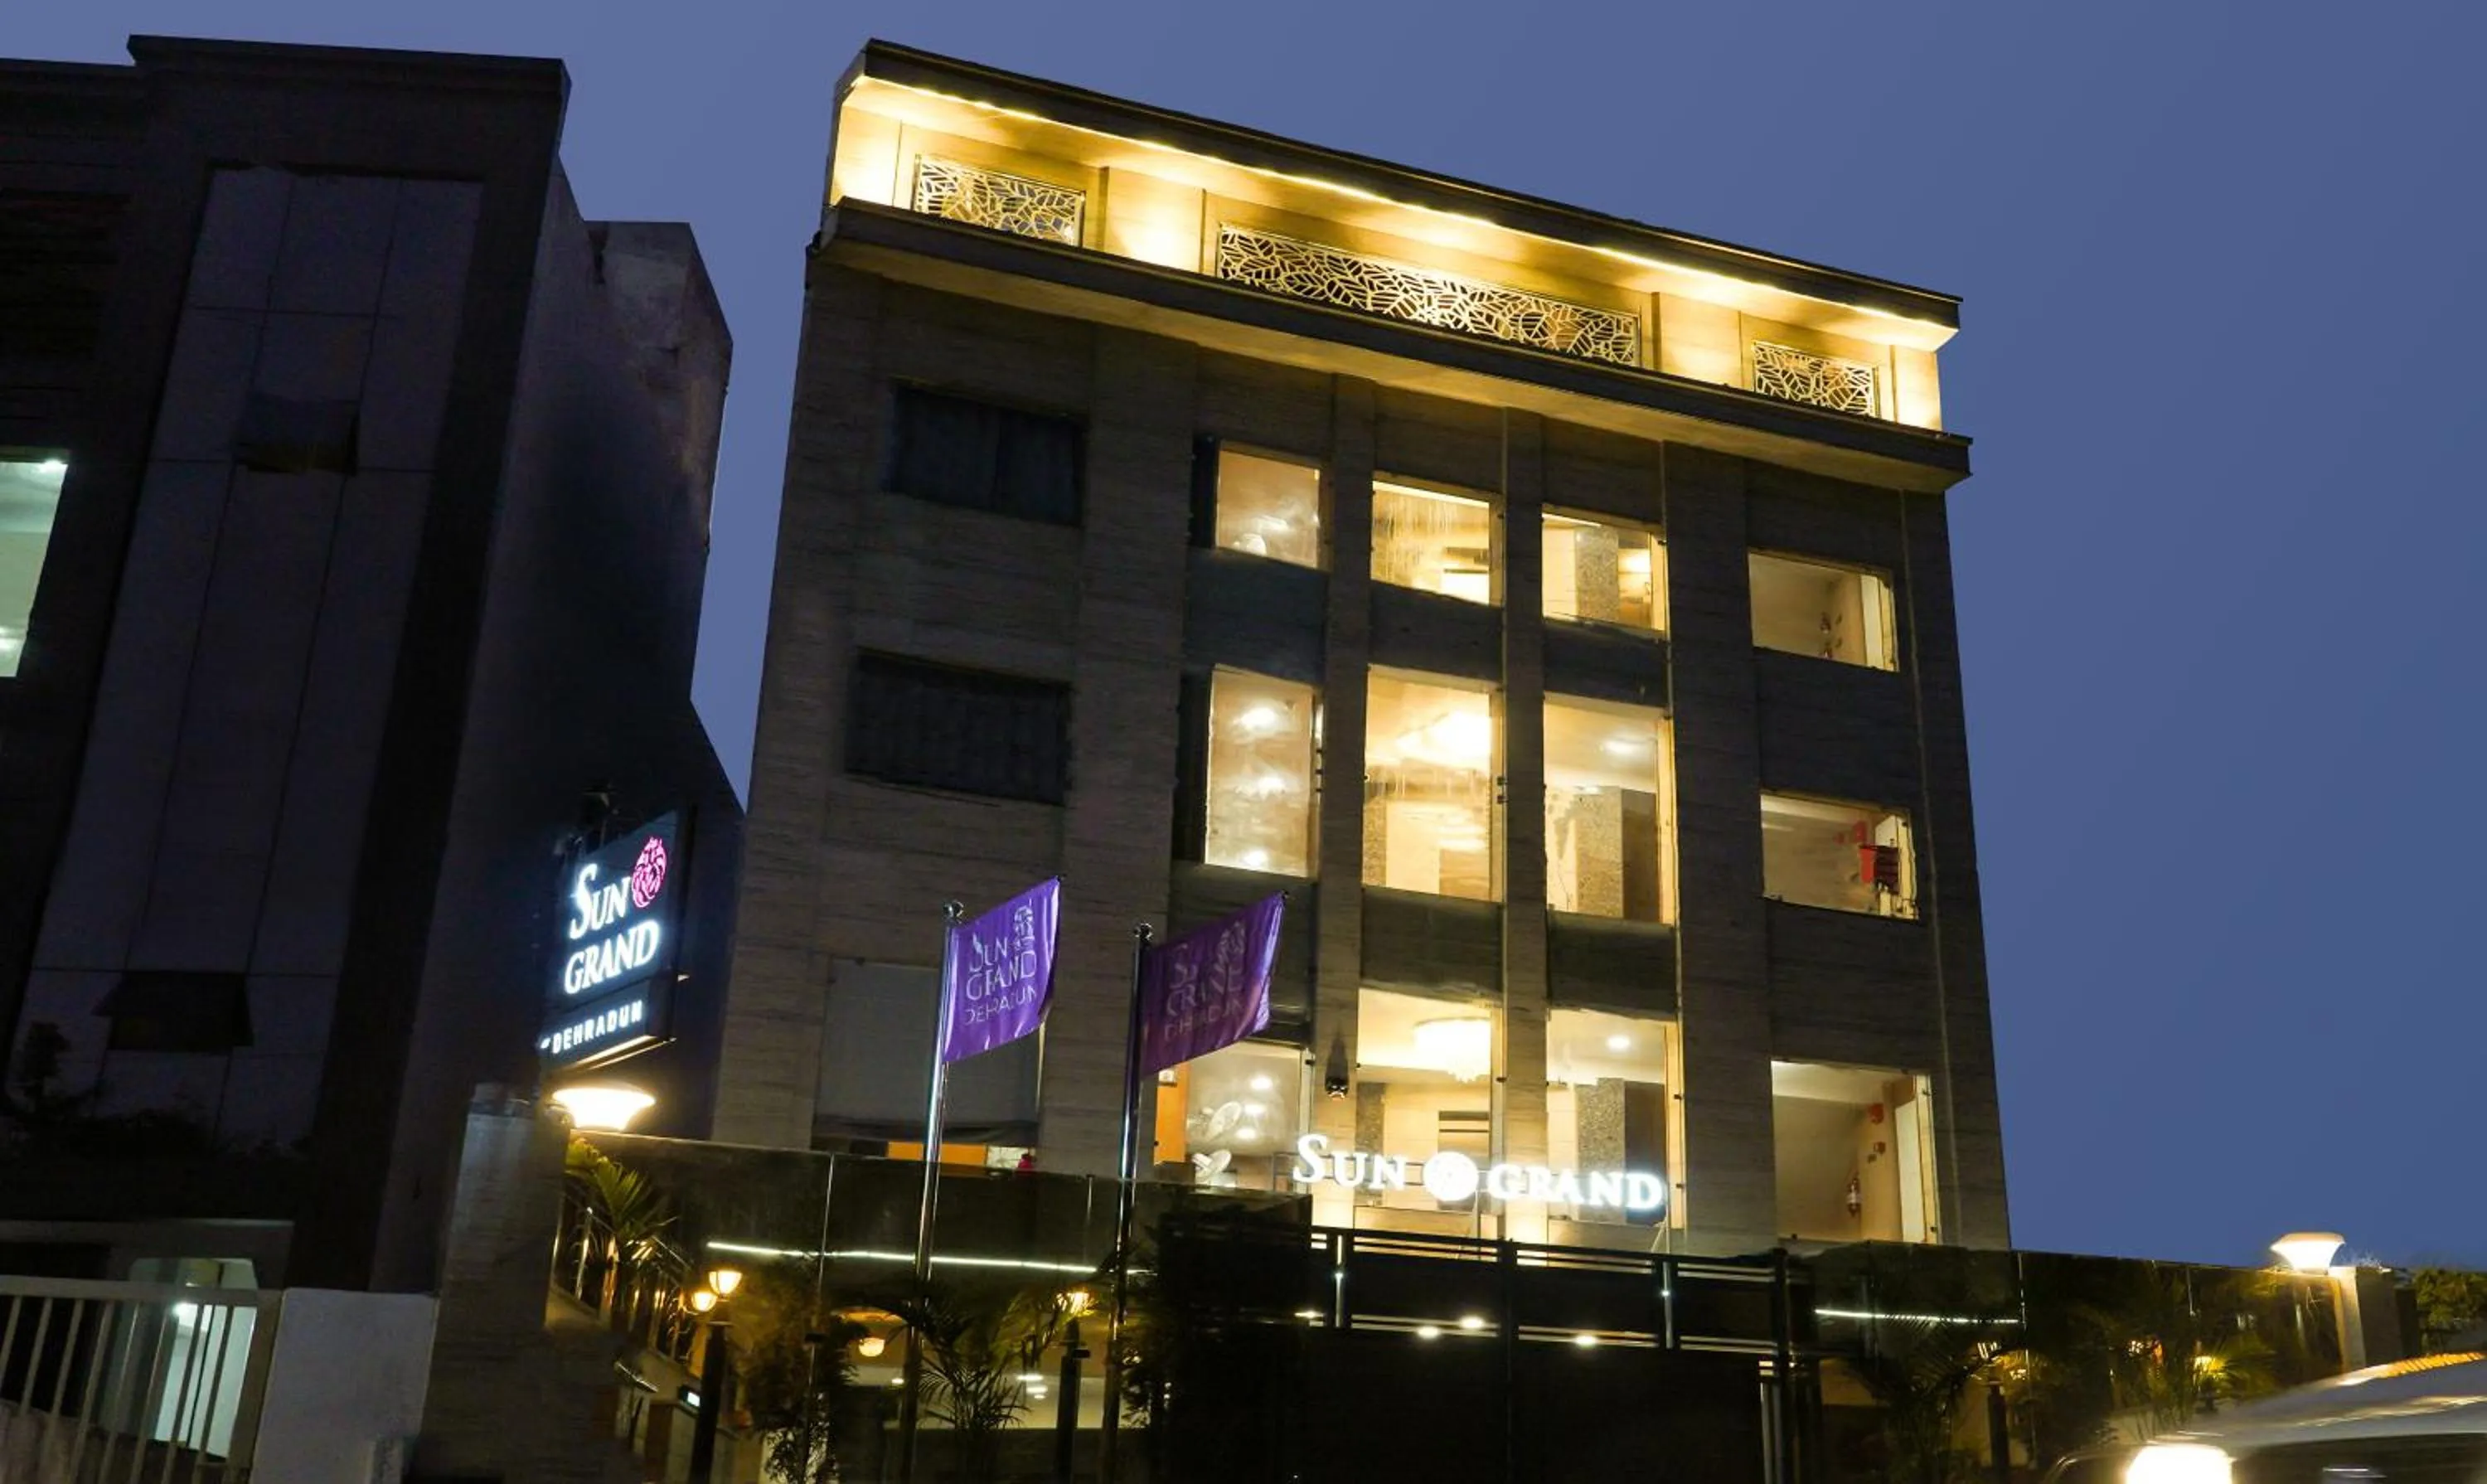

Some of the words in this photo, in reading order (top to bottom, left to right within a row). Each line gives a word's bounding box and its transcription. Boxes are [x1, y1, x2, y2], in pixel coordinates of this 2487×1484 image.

[570, 863, 631, 939] SUN
[564, 919, 661, 995] GRAND
[552, 1000, 642, 1054] DEHRADUN
[1292, 1133, 1408, 1191] SUN
[1487, 1162, 1667, 1210] GRAND
